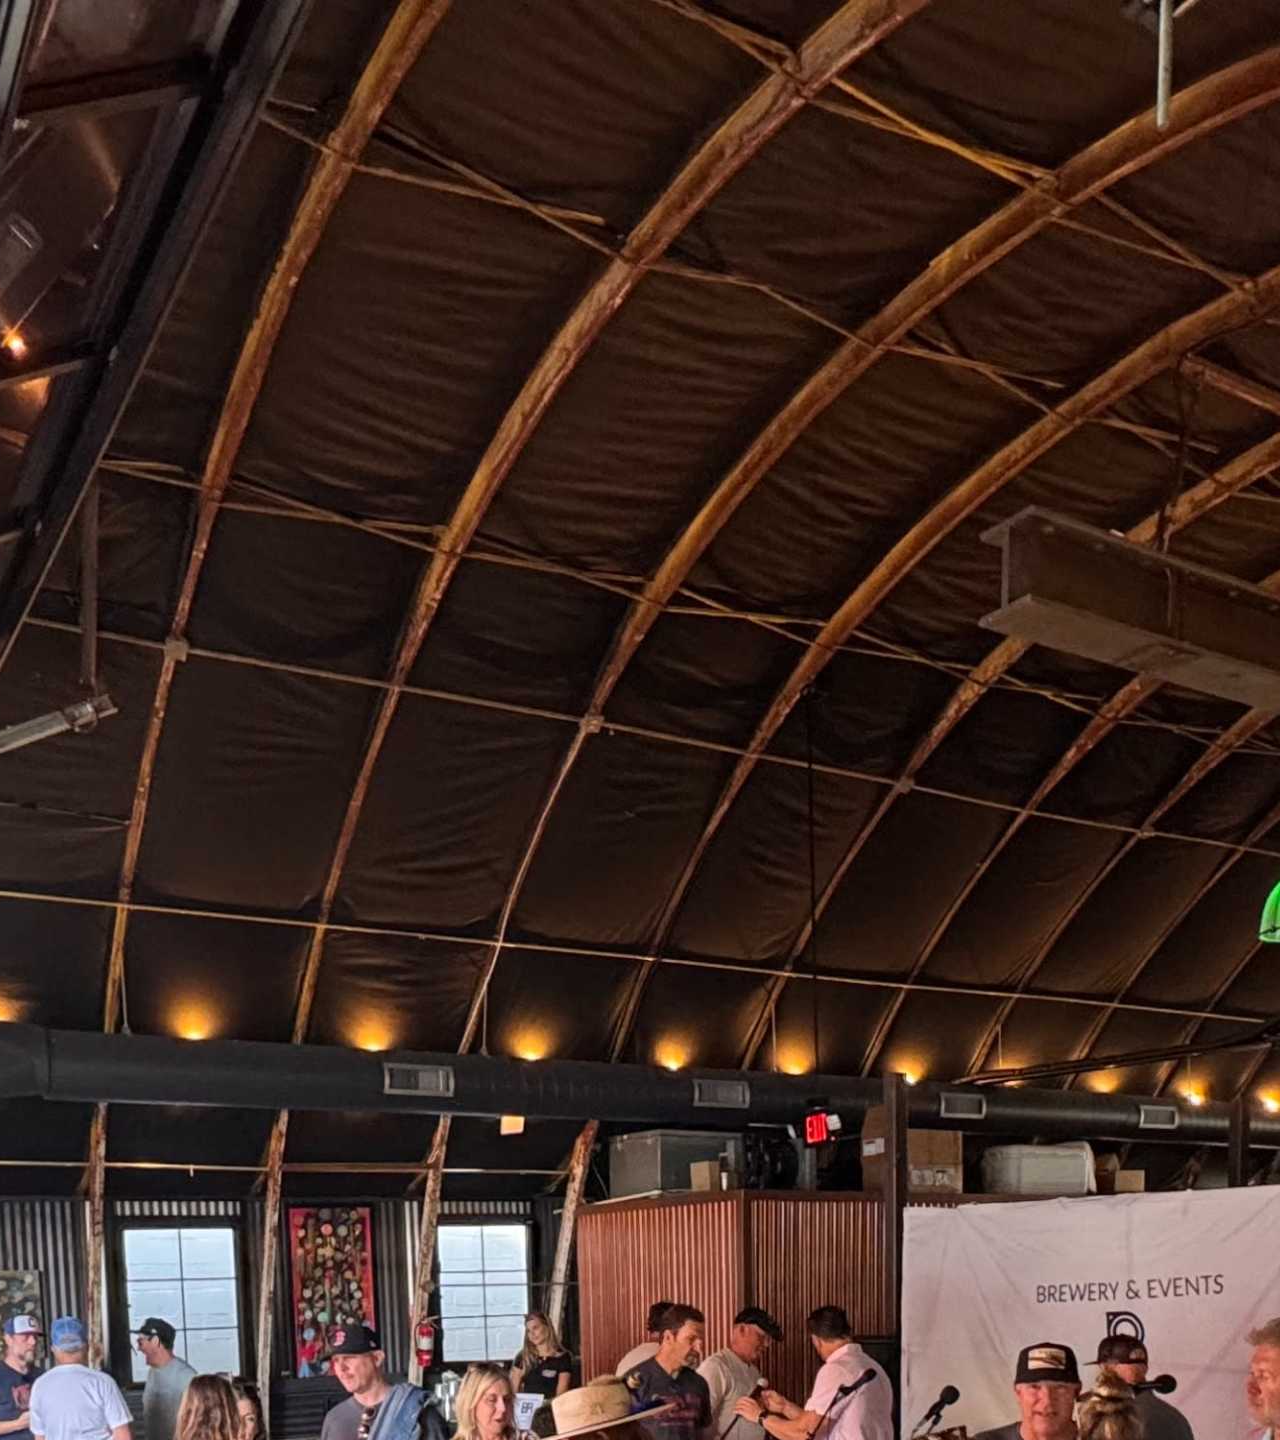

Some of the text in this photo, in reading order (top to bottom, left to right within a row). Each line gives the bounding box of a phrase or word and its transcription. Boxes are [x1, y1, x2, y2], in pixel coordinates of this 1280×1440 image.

[1036, 1273, 1225, 1304] BREWERY & EVENTS
